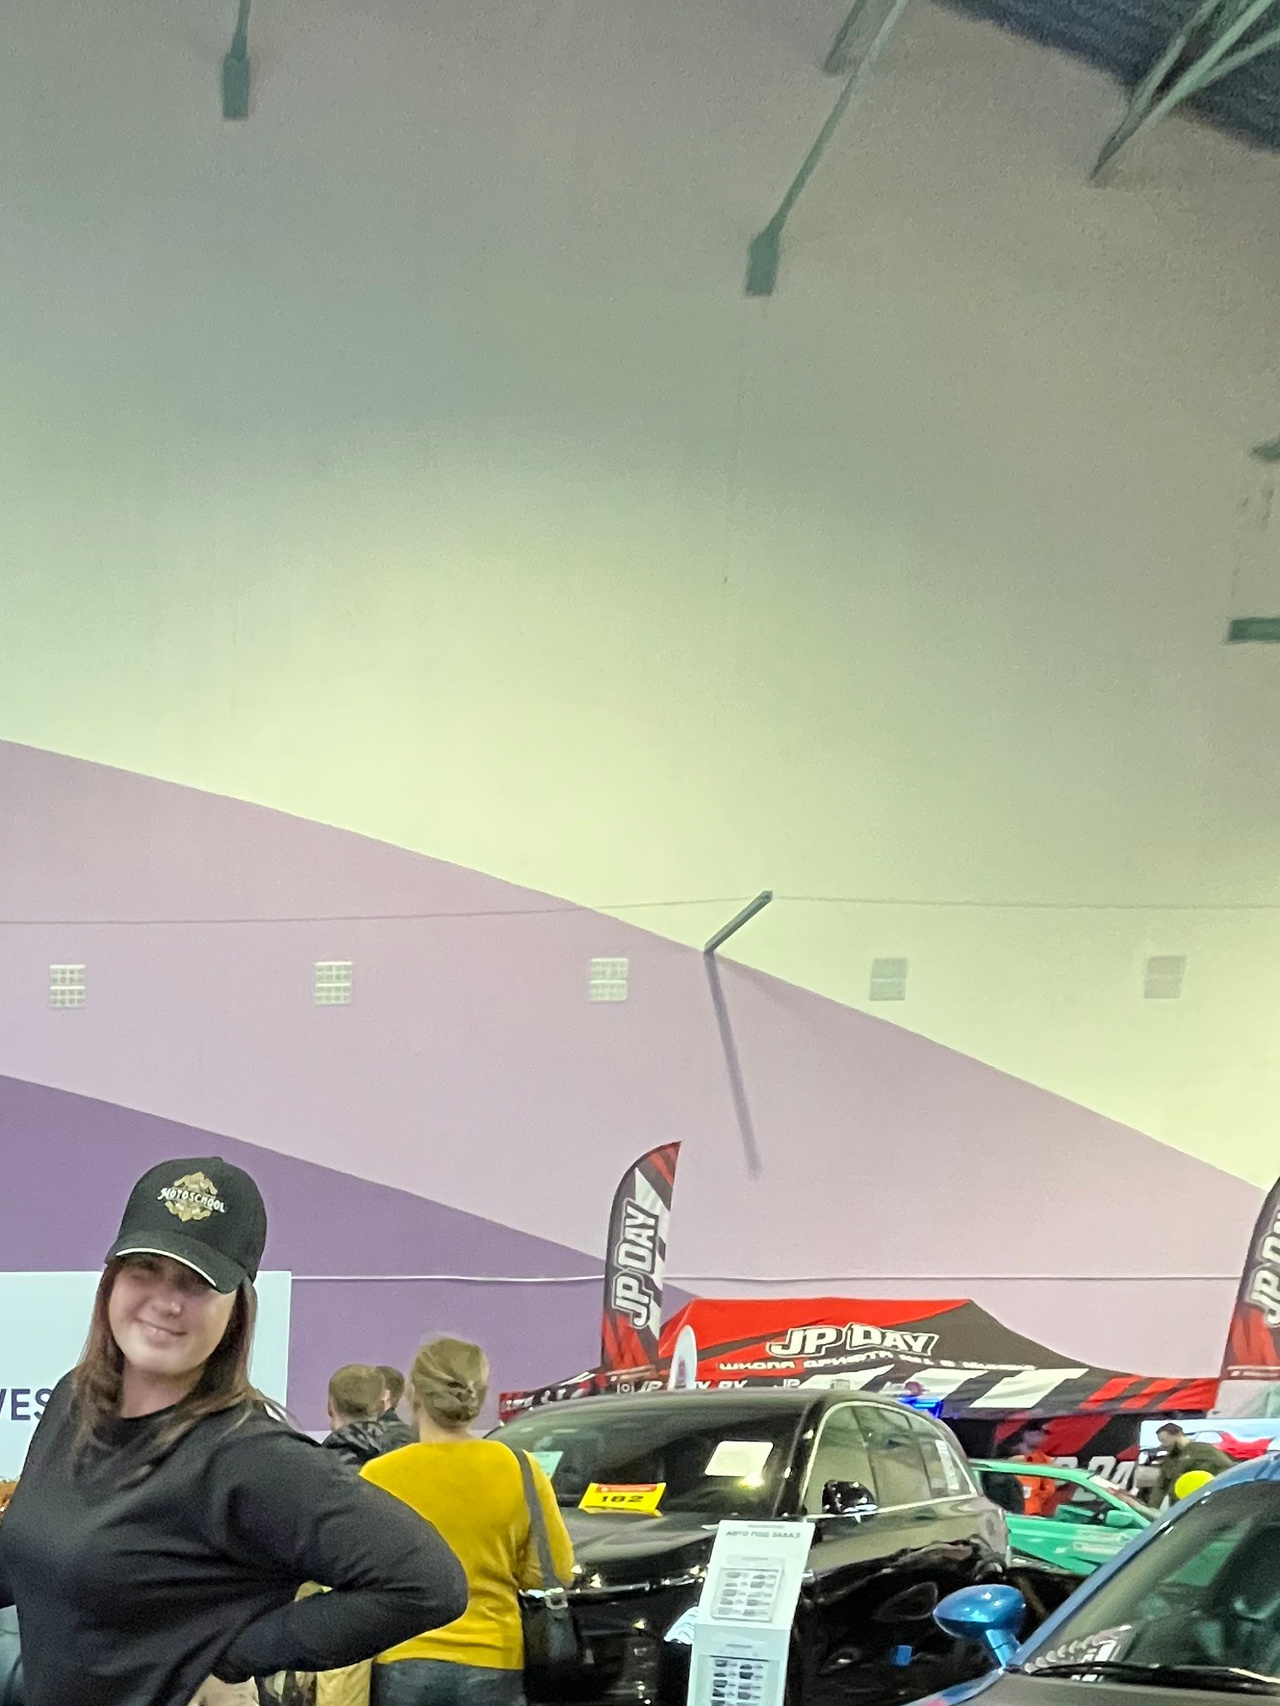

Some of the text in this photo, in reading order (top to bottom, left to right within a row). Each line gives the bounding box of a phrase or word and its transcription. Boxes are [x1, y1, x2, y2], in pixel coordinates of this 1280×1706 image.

[157, 1187, 225, 1213] MOTOSCHOOL
[614, 1203, 658, 1327] JP DAY
[770, 1323, 931, 1356] JP DAY
